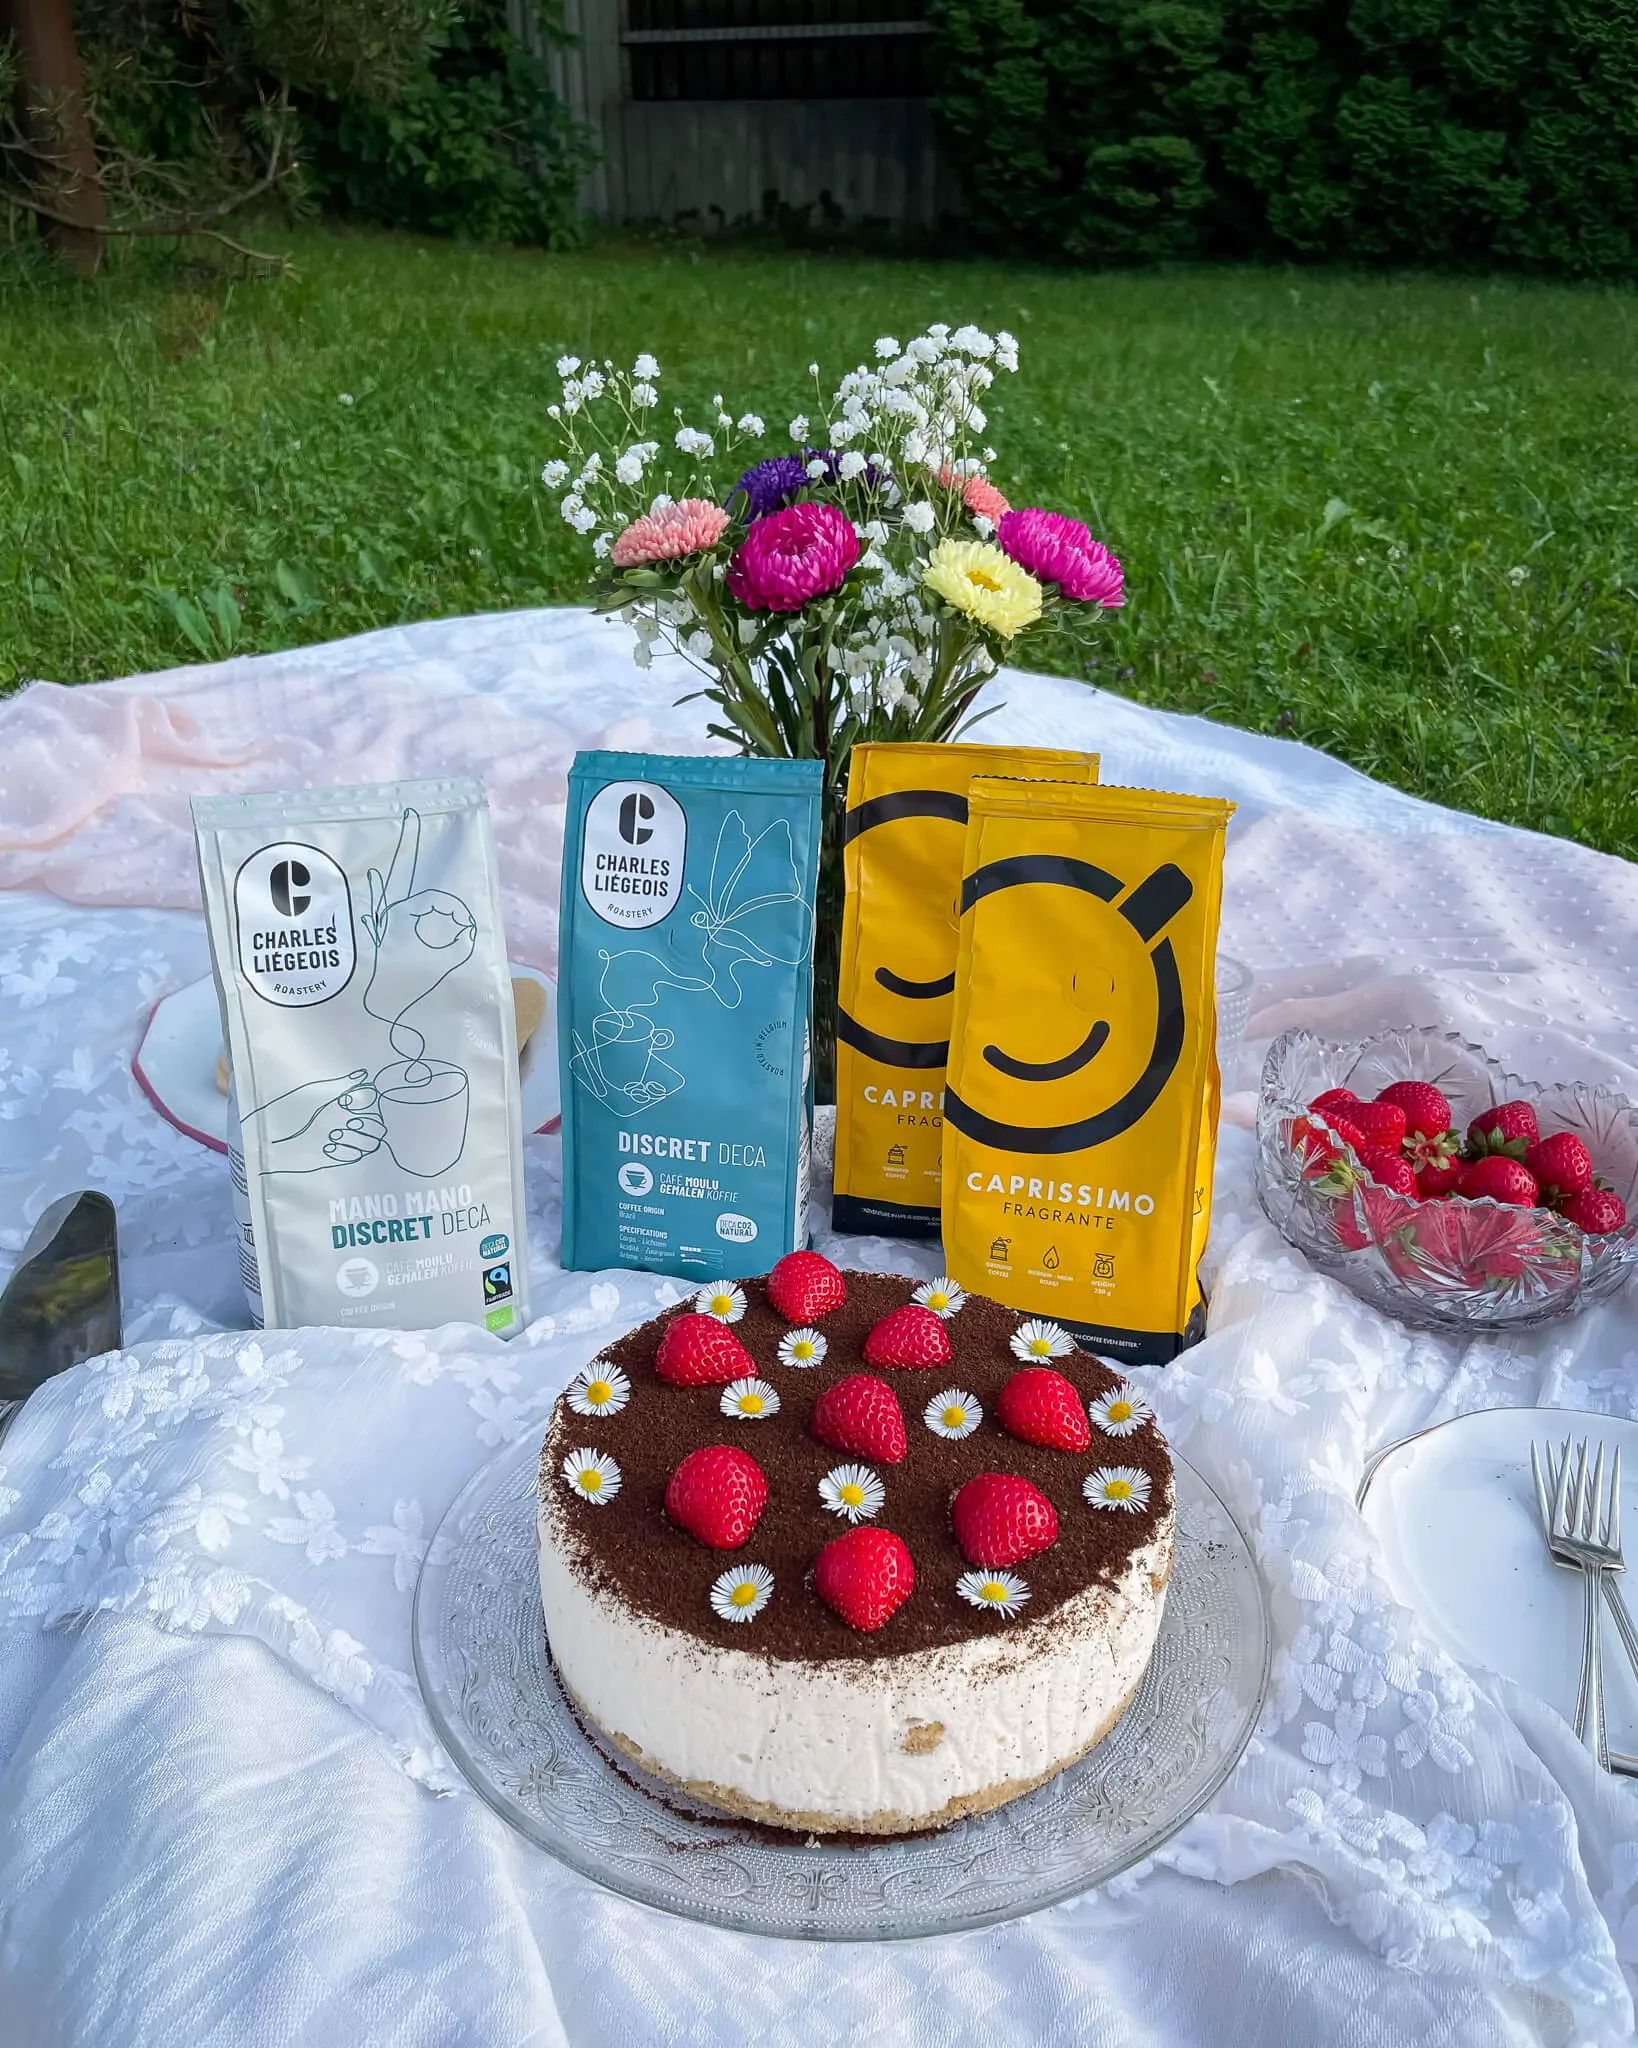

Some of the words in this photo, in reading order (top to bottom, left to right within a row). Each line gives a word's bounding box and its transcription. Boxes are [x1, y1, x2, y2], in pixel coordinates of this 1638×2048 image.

[596, 854, 670, 876] CHARLES
[594, 874, 669, 897] LIÉGEOIS
[607, 903, 653, 918] ROASTERY
[253, 926, 337, 950] CHARLES
[253, 949, 340, 973] LIÉGEOIS
[273, 980, 328, 995] ROASTERY
[759, 1020, 787, 1040] BELGIUM
[618, 1131, 712, 1162] DISCRET
[718, 1143, 766, 1167] DECA
[685, 1177, 719, 1190] MOULU
[660, 1184, 704, 1199] GEMALEN
[706, 1190, 739, 1203] KOFFIE
[966, 1171, 1155, 1216] CAPRISSIMO
[329, 1193, 398, 1223] MANO
[405, 1184, 472, 1212] MANO
[619, 1202, 642, 1212] COFFEE
[643, 1205, 665, 1216] ORIGIN
[619, 1210, 636, 1220] Brazil
[720, 1219, 736, 1229] DECA
[1003, 1201, 1115, 1230] FRAGRANTE
[331, 1215, 433, 1250] DISCRET
[442, 1203, 490, 1236] DECA
[619, 1225, 668, 1240] SPECIFICATIONS
[720, 1228, 753, 1237] NATURAL
[416, 1252, 453, 1269] MOULU
[387, 1268, 438, 1286] GEMALEN
[1091, 1280, 1116, 1289] WEIGHT
[1082, 1334, 1102, 1343] COFFEE
[1103, 1337, 1118, 1346] EVEN
